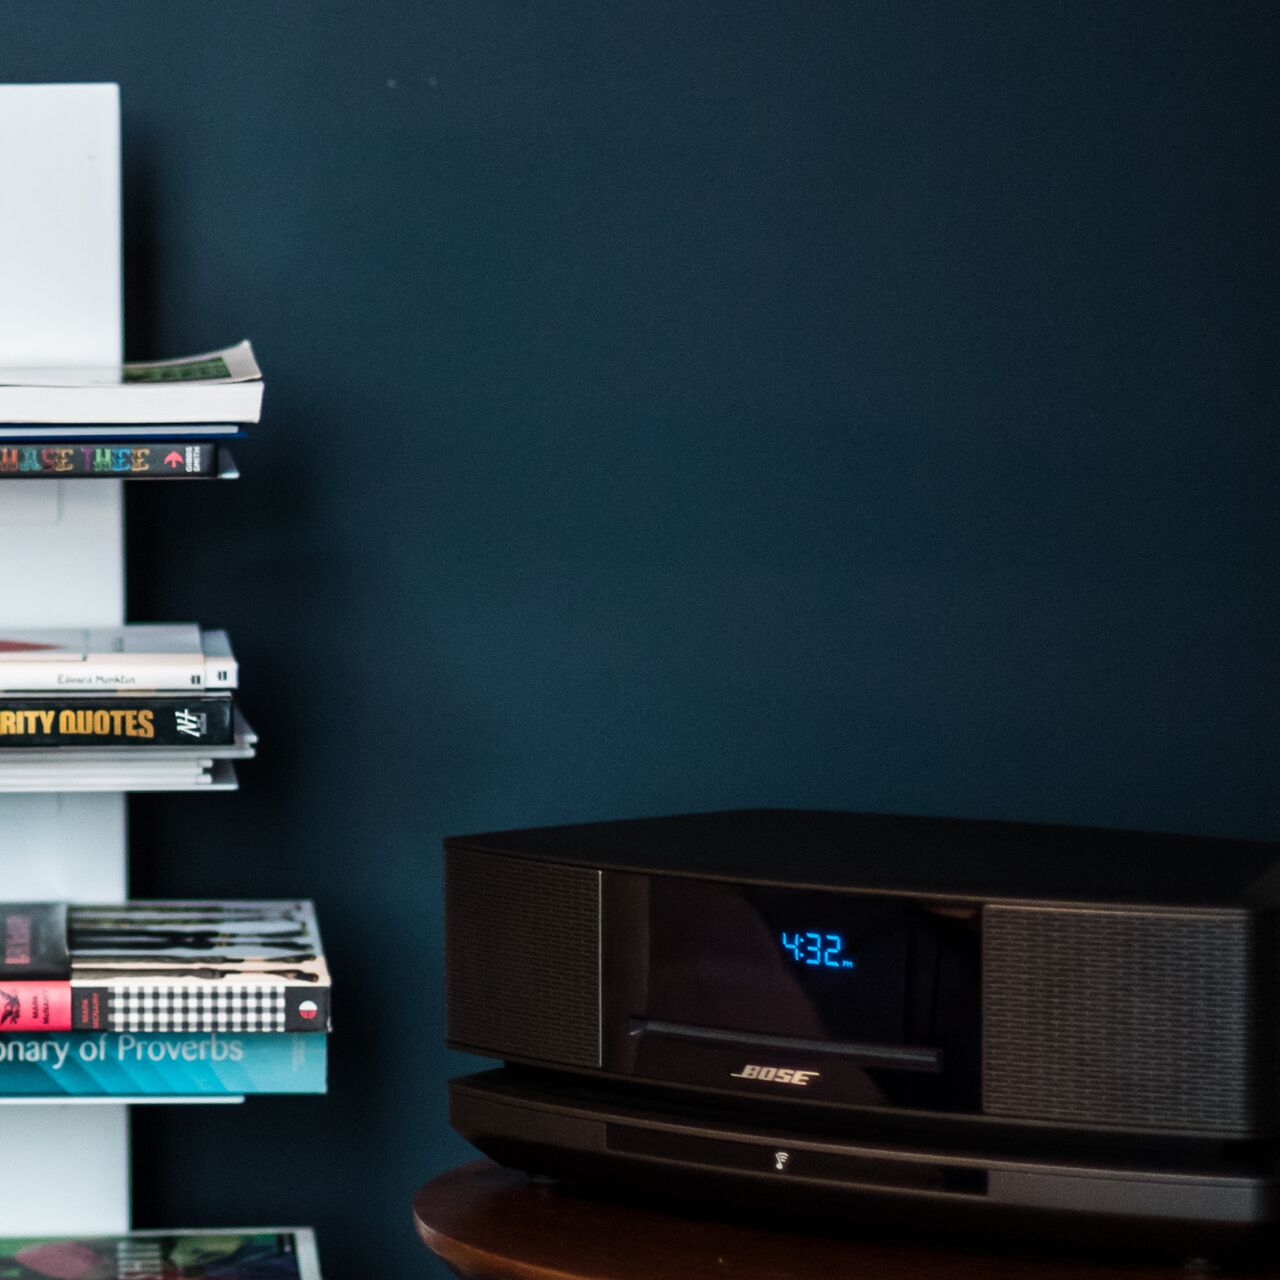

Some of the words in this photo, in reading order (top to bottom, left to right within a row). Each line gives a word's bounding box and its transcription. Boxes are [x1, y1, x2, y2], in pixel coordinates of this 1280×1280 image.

[81, 447, 150, 472] THEE
[58, 709, 155, 739] QUOTES
[782, 932, 841, 967] 4:32
[79, 1035, 107, 1061] of
[118, 1036, 245, 1061] Proverbs
[730, 1064, 820, 1086] BOSE
